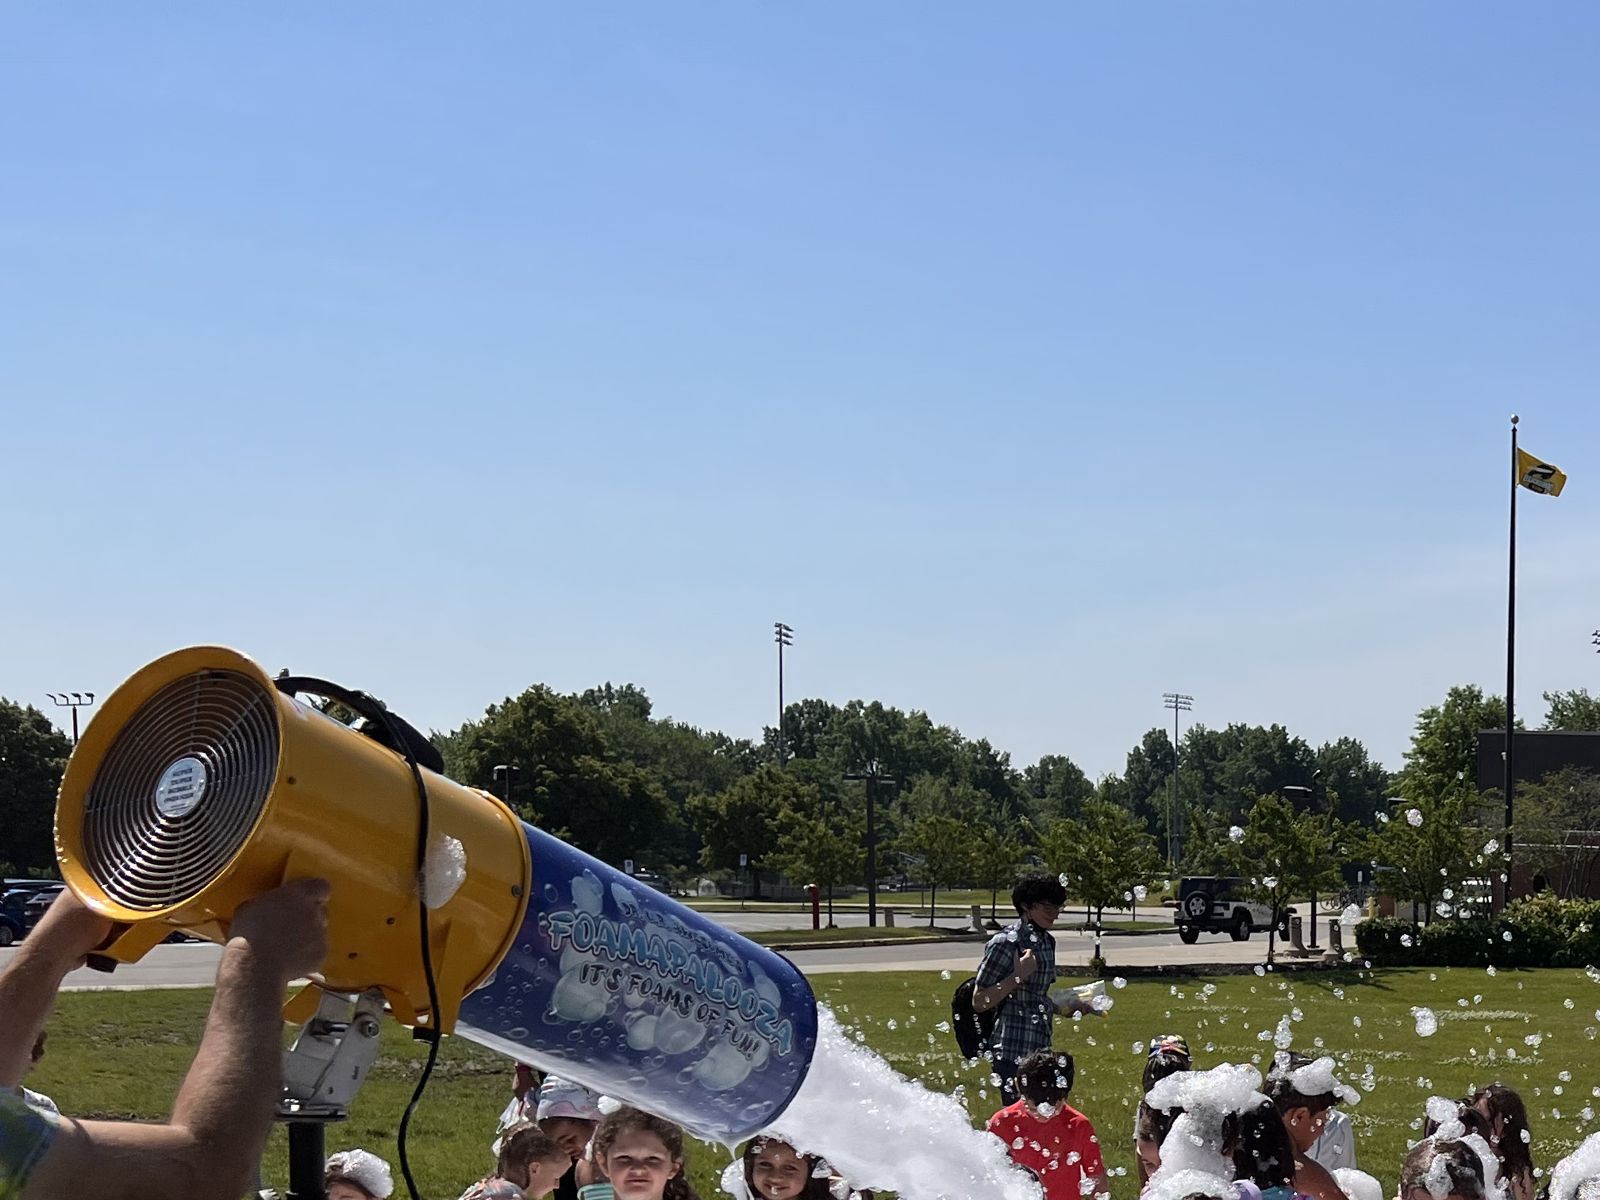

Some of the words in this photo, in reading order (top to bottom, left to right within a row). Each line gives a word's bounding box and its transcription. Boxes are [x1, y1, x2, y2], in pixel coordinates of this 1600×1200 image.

[548, 911, 792, 1056] FOAMAPALOOZA
[580, 962, 624, 992] IT'S
[629, 973, 696, 1018] FOAMS
[697, 1001, 721, 1025] OF
[721, 1020, 761, 1061] FUN!
